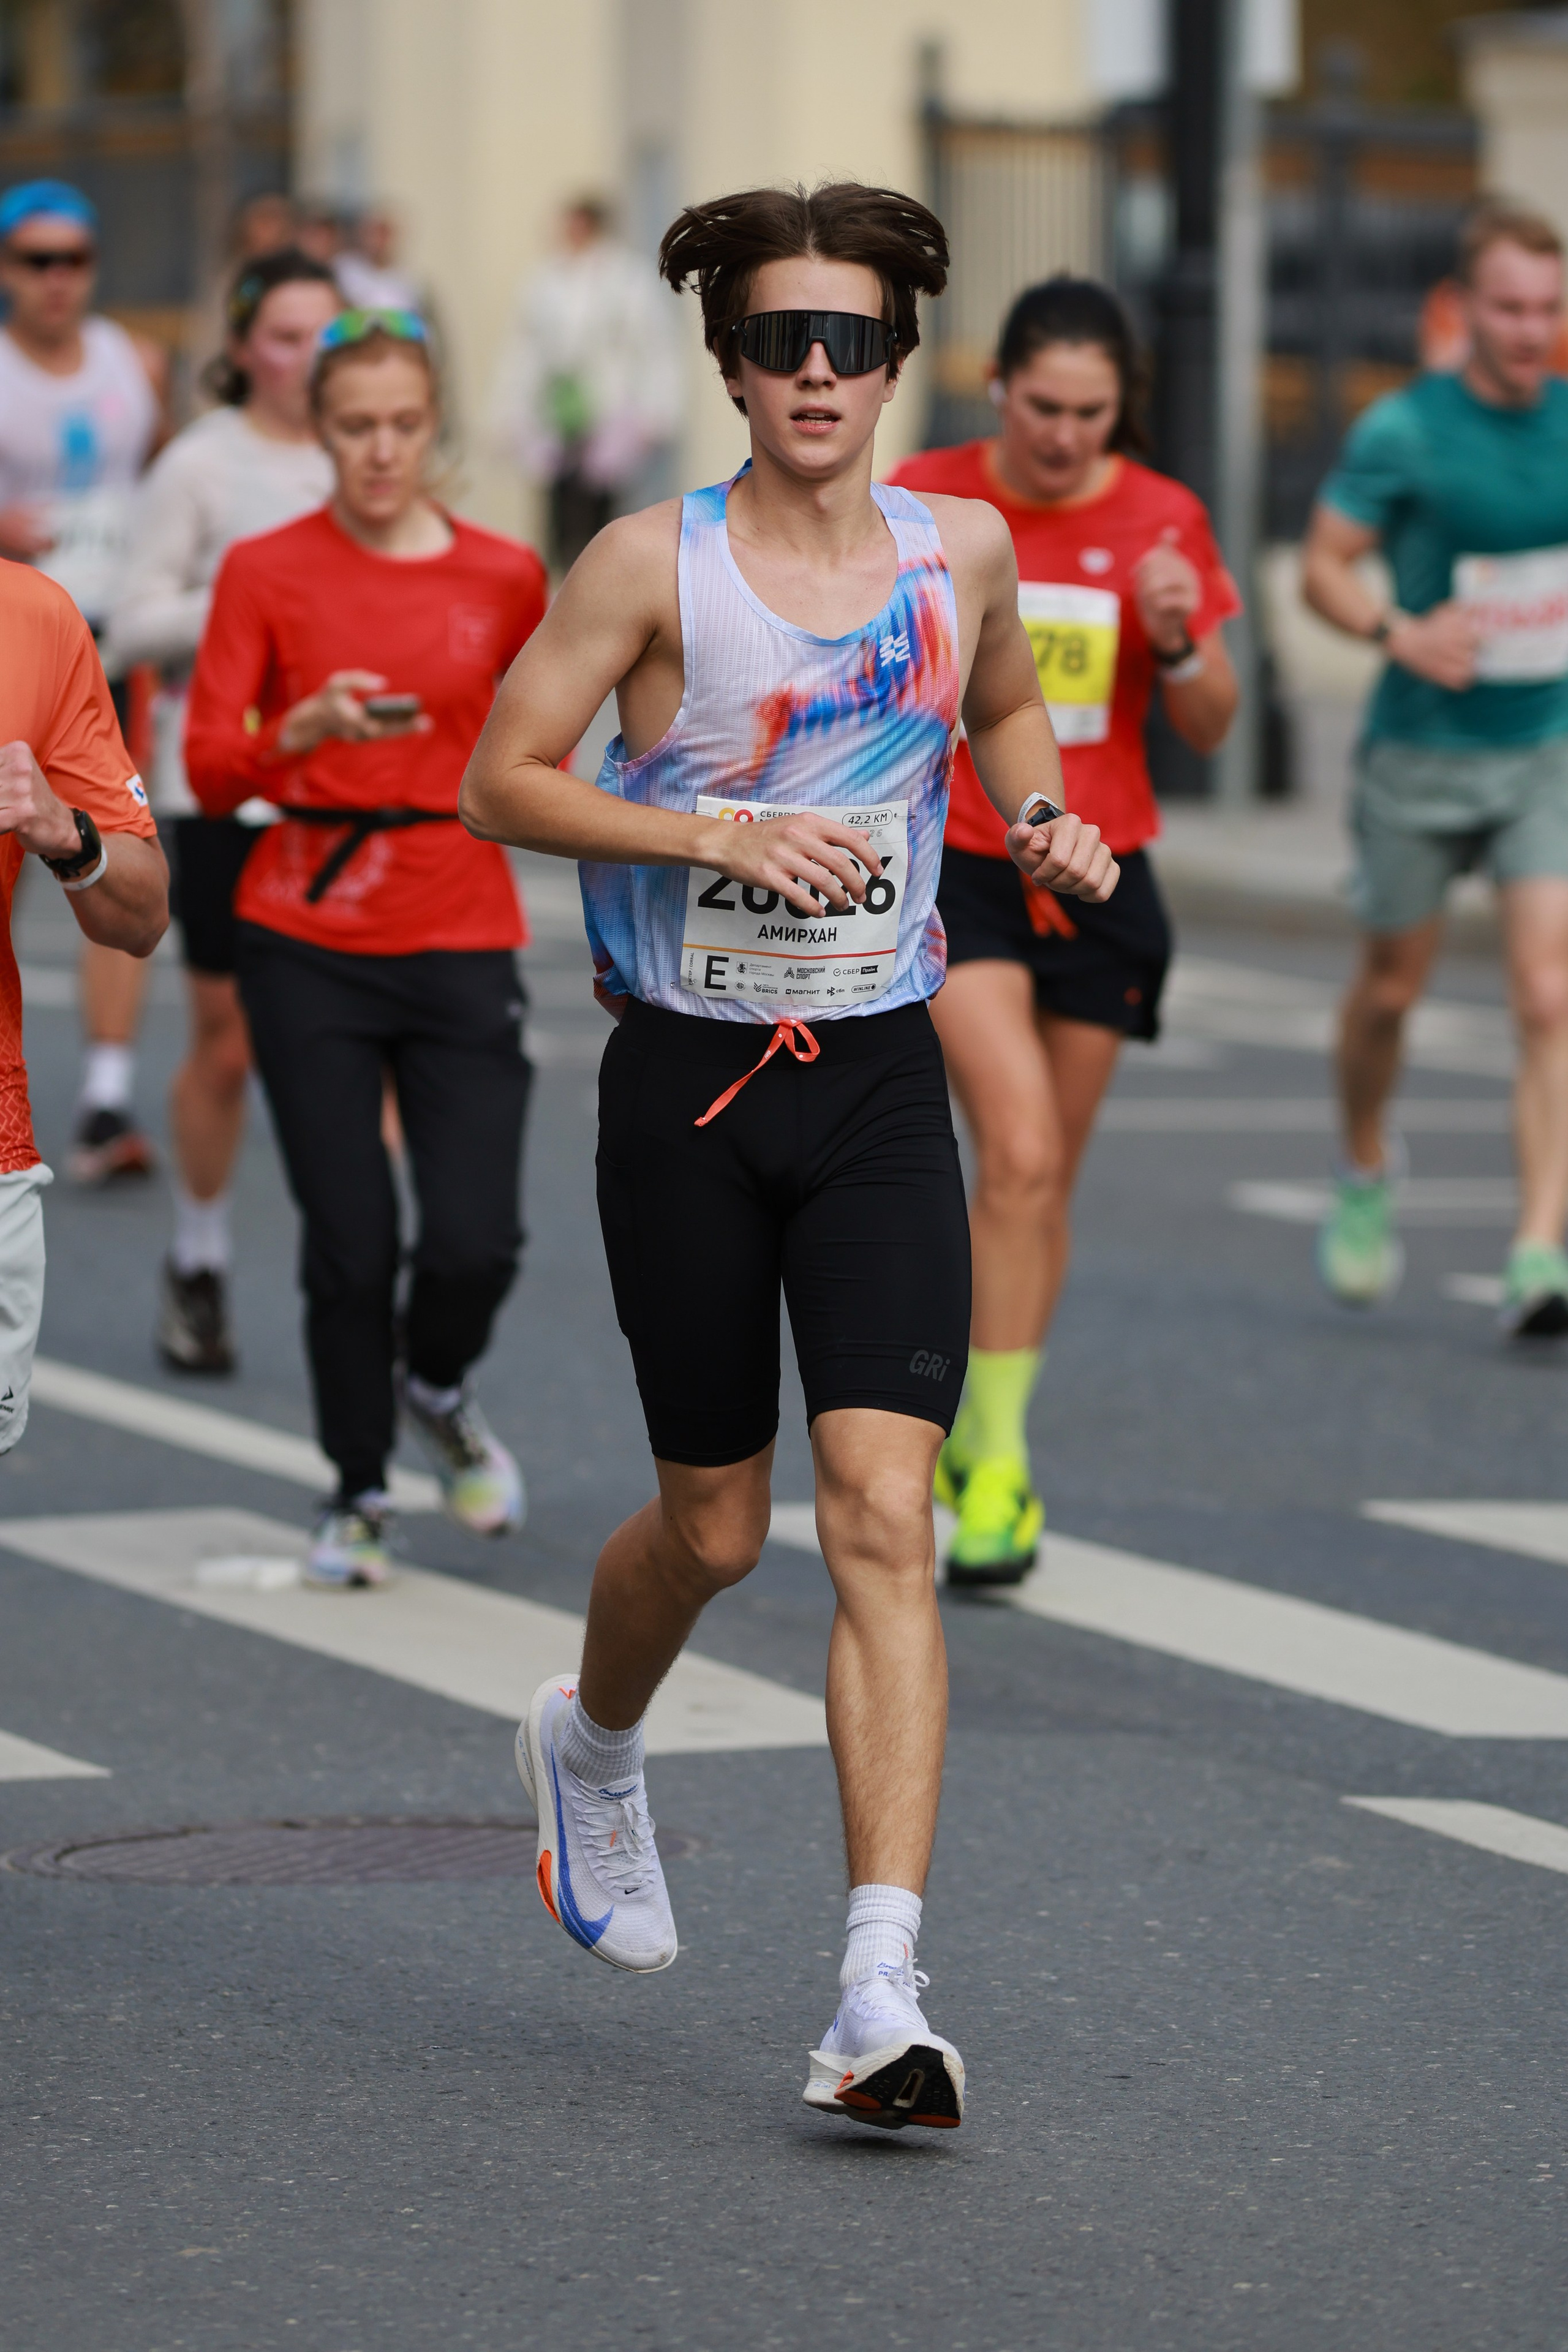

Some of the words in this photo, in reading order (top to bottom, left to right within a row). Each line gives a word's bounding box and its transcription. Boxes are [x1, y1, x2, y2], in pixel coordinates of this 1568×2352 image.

[848, 815, 870, 825] 42,2
[874, 813, 888, 823] КМ
[757, 924, 837, 943] АМИРХАН
[704, 955, 729, 990] E
